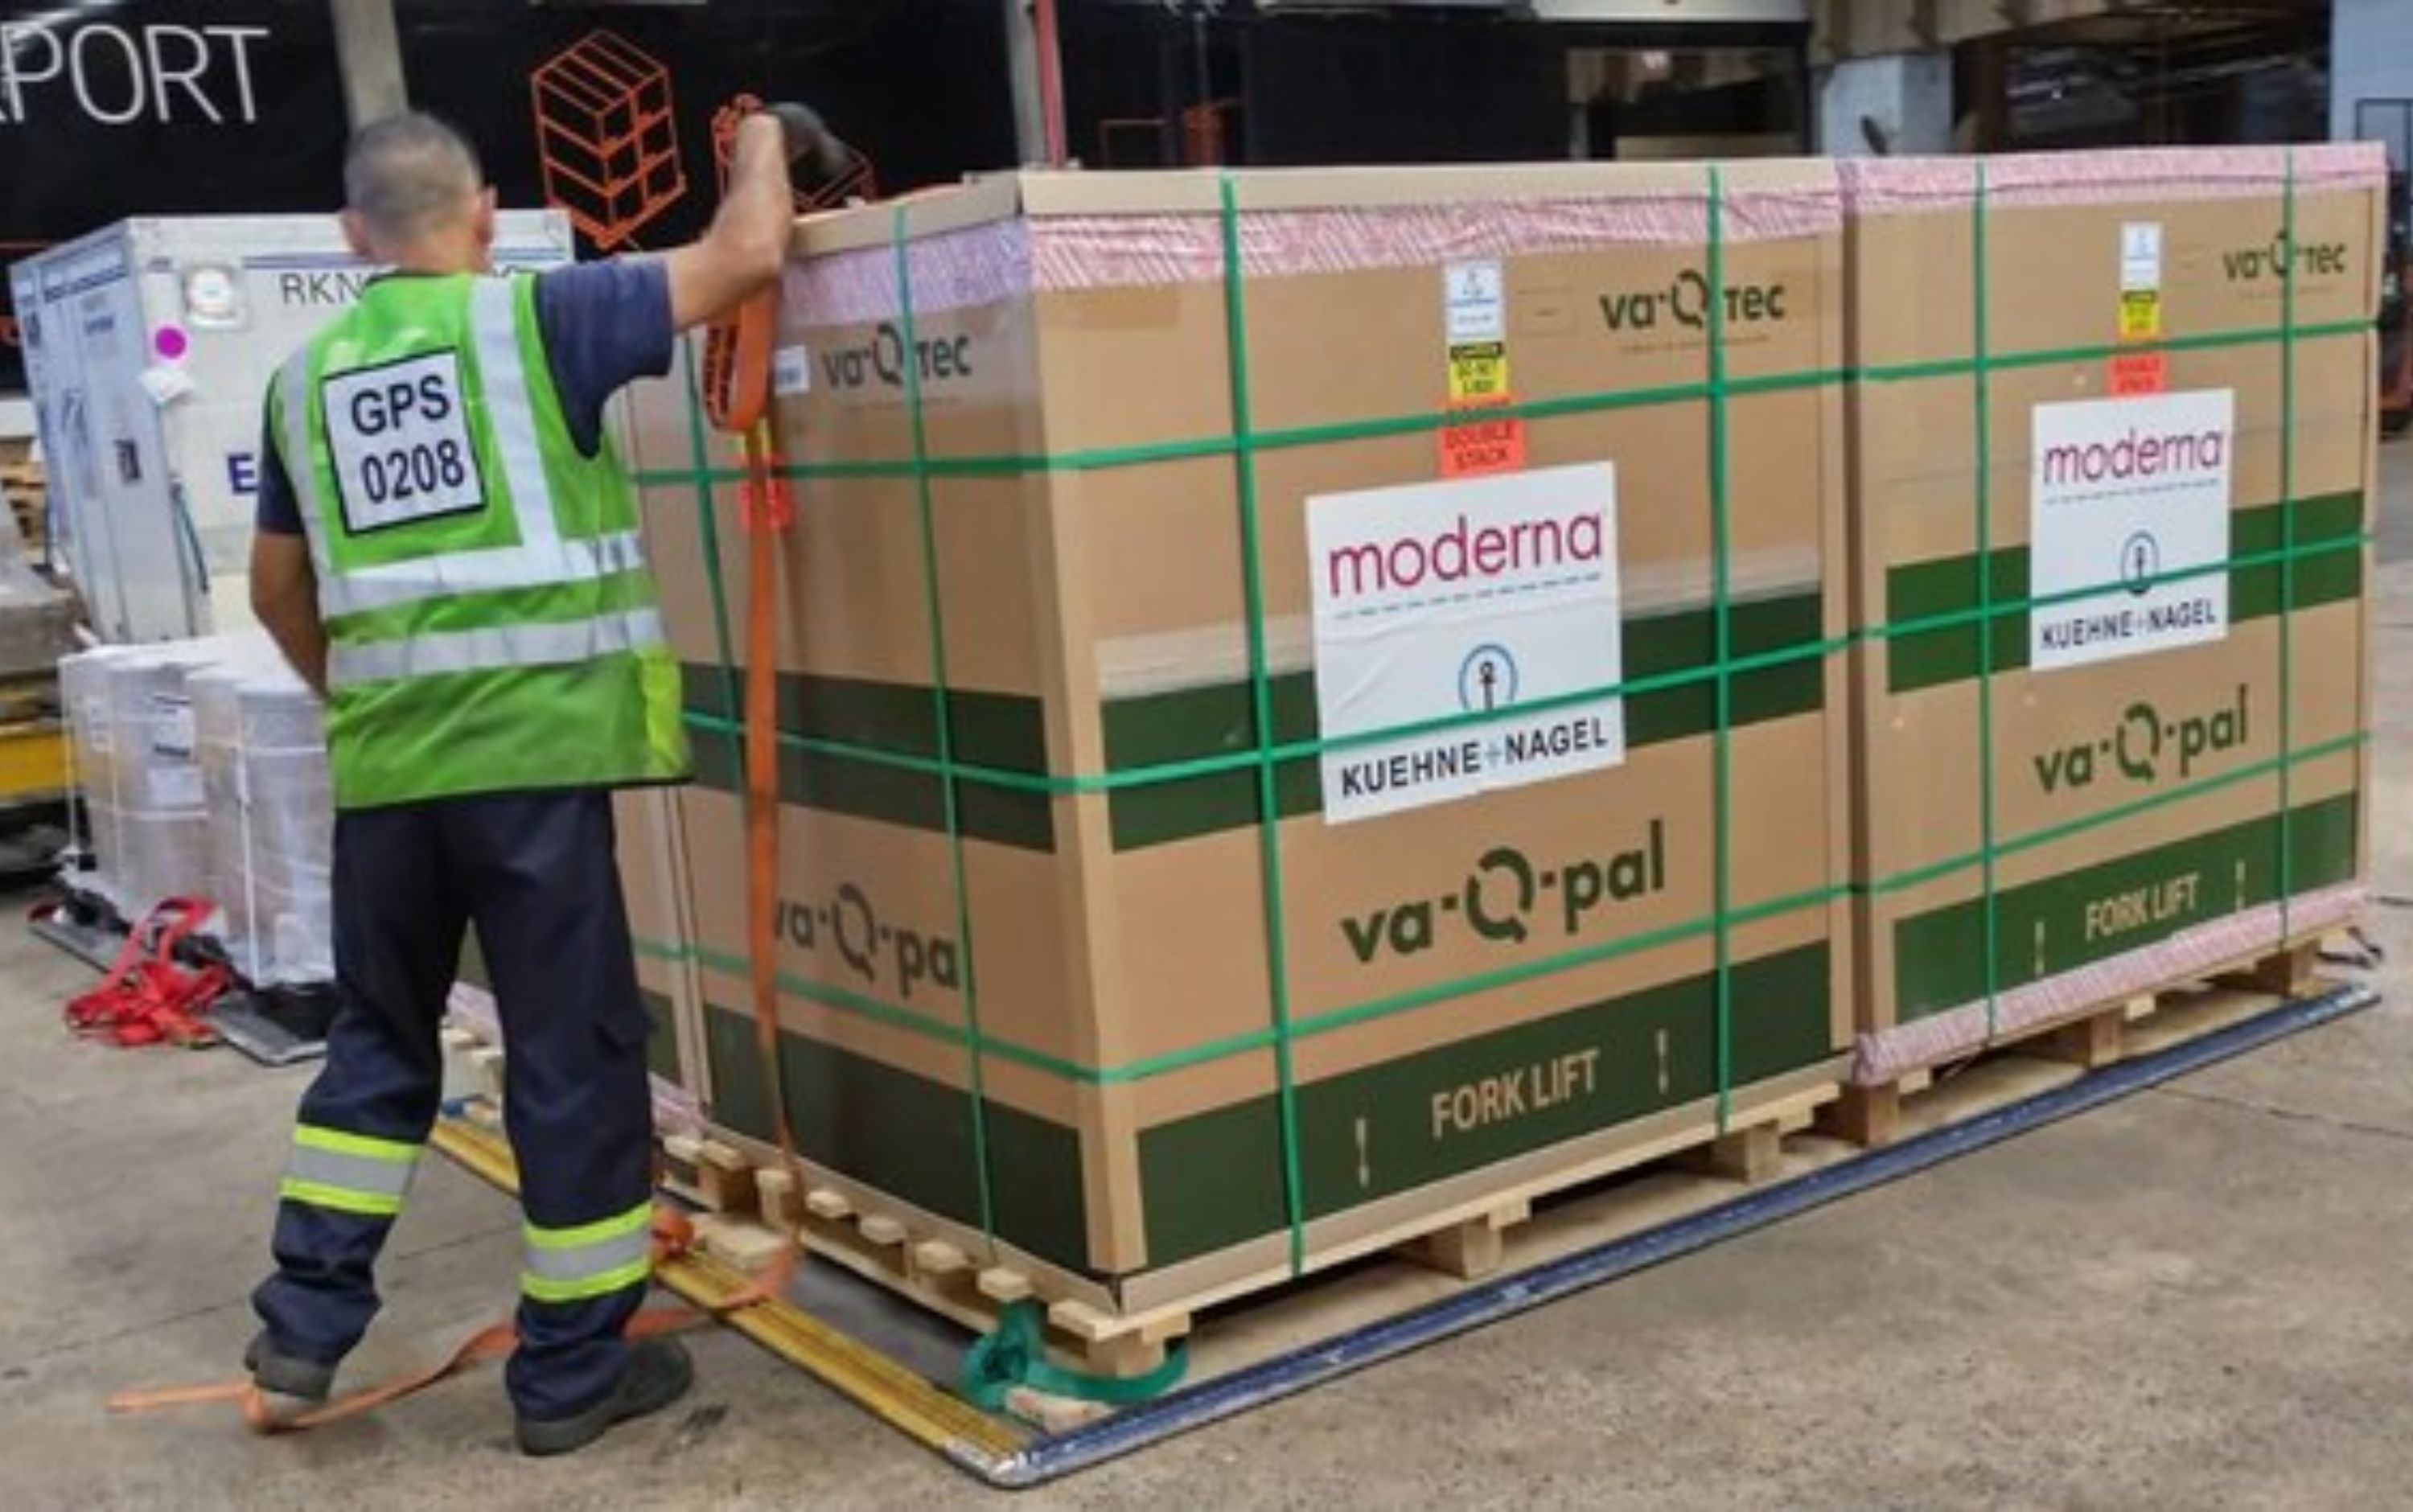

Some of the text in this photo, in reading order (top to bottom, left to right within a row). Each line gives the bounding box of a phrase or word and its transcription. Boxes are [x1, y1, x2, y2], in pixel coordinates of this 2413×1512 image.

[0, 22, 269, 122] PORT
[351, 374, 450, 435] GPS
[361, 439, 464, 503] 0208
[2043, 427, 2224, 484] moderna
[1330, 513, 1601, 598] moderna
[2087, 872, 2201, 939] FORK LIFT
[1432, 1049, 1600, 1138] FORK LIFT
